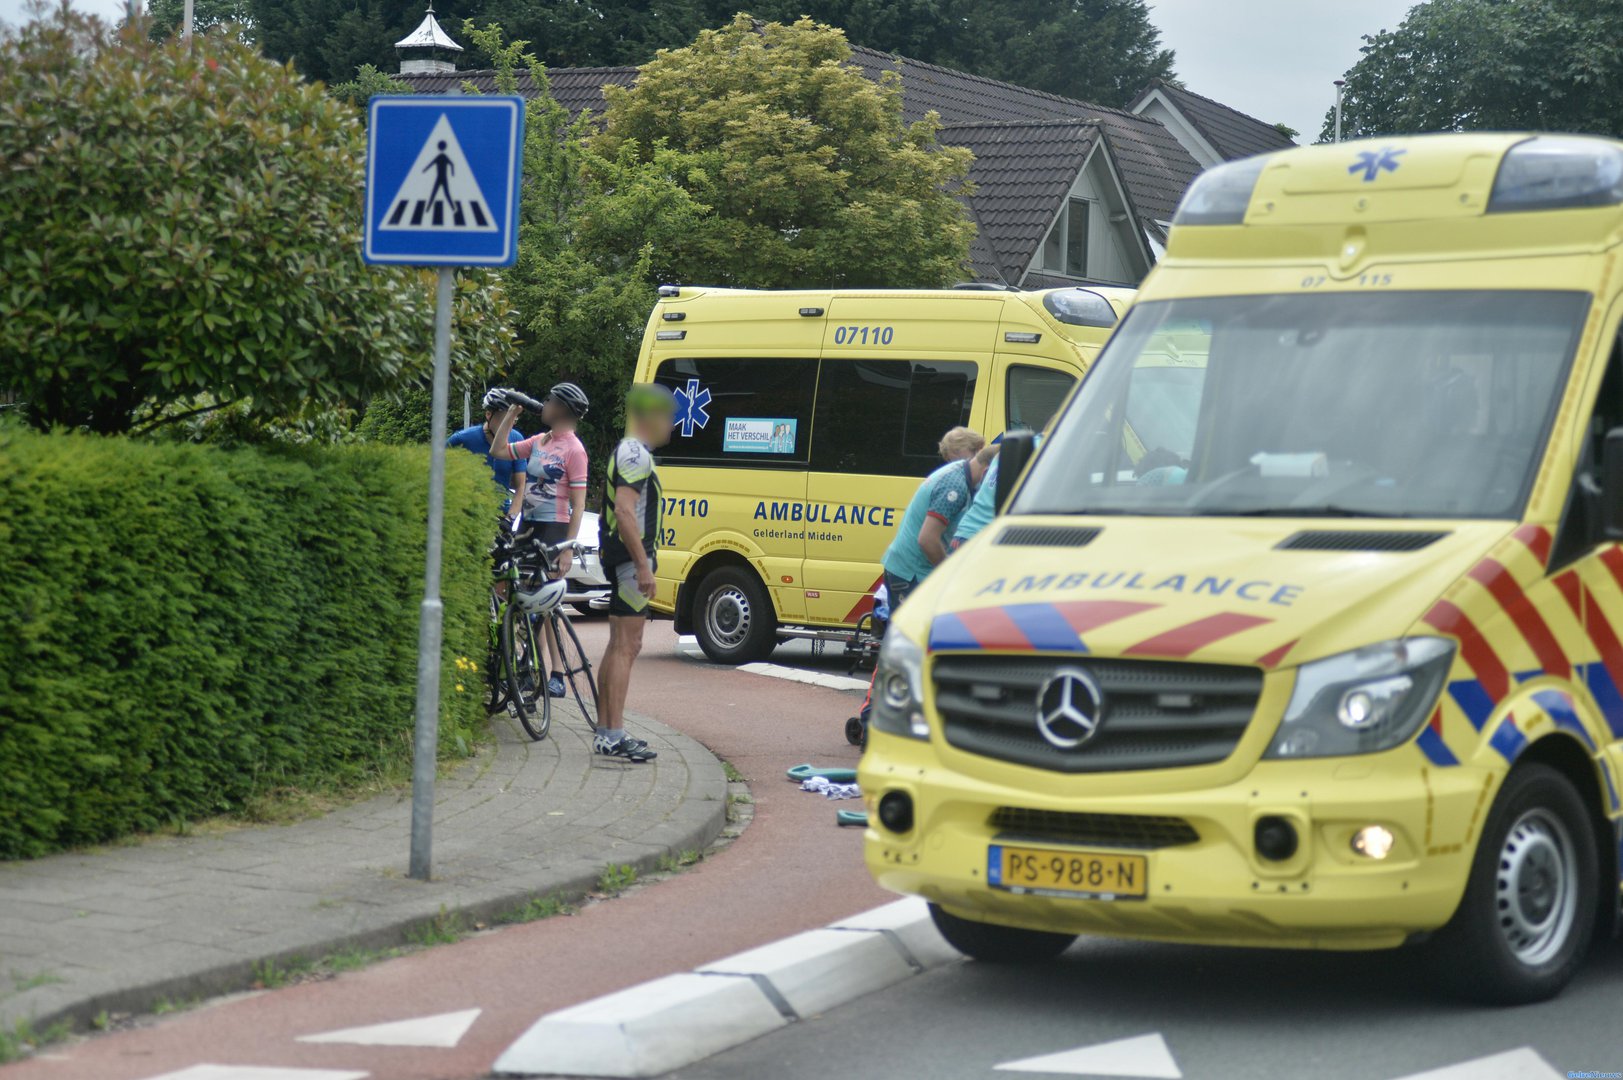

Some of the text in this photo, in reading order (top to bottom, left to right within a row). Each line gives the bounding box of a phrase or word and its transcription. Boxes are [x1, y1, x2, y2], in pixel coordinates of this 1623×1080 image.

[1359, 273, 1392, 287] 115
[834, 326, 894, 345] 07110
[728, 422, 747, 431] MAAK
[727, 431, 770, 441] HET VERSCHIL
[753, 501, 896, 527] AMBULANCE
[753, 528, 843, 542] Gelderland Midden
[973, 572, 1305, 606] AMBULANCE
[1008, 853, 1136, 888] PS-988-N
